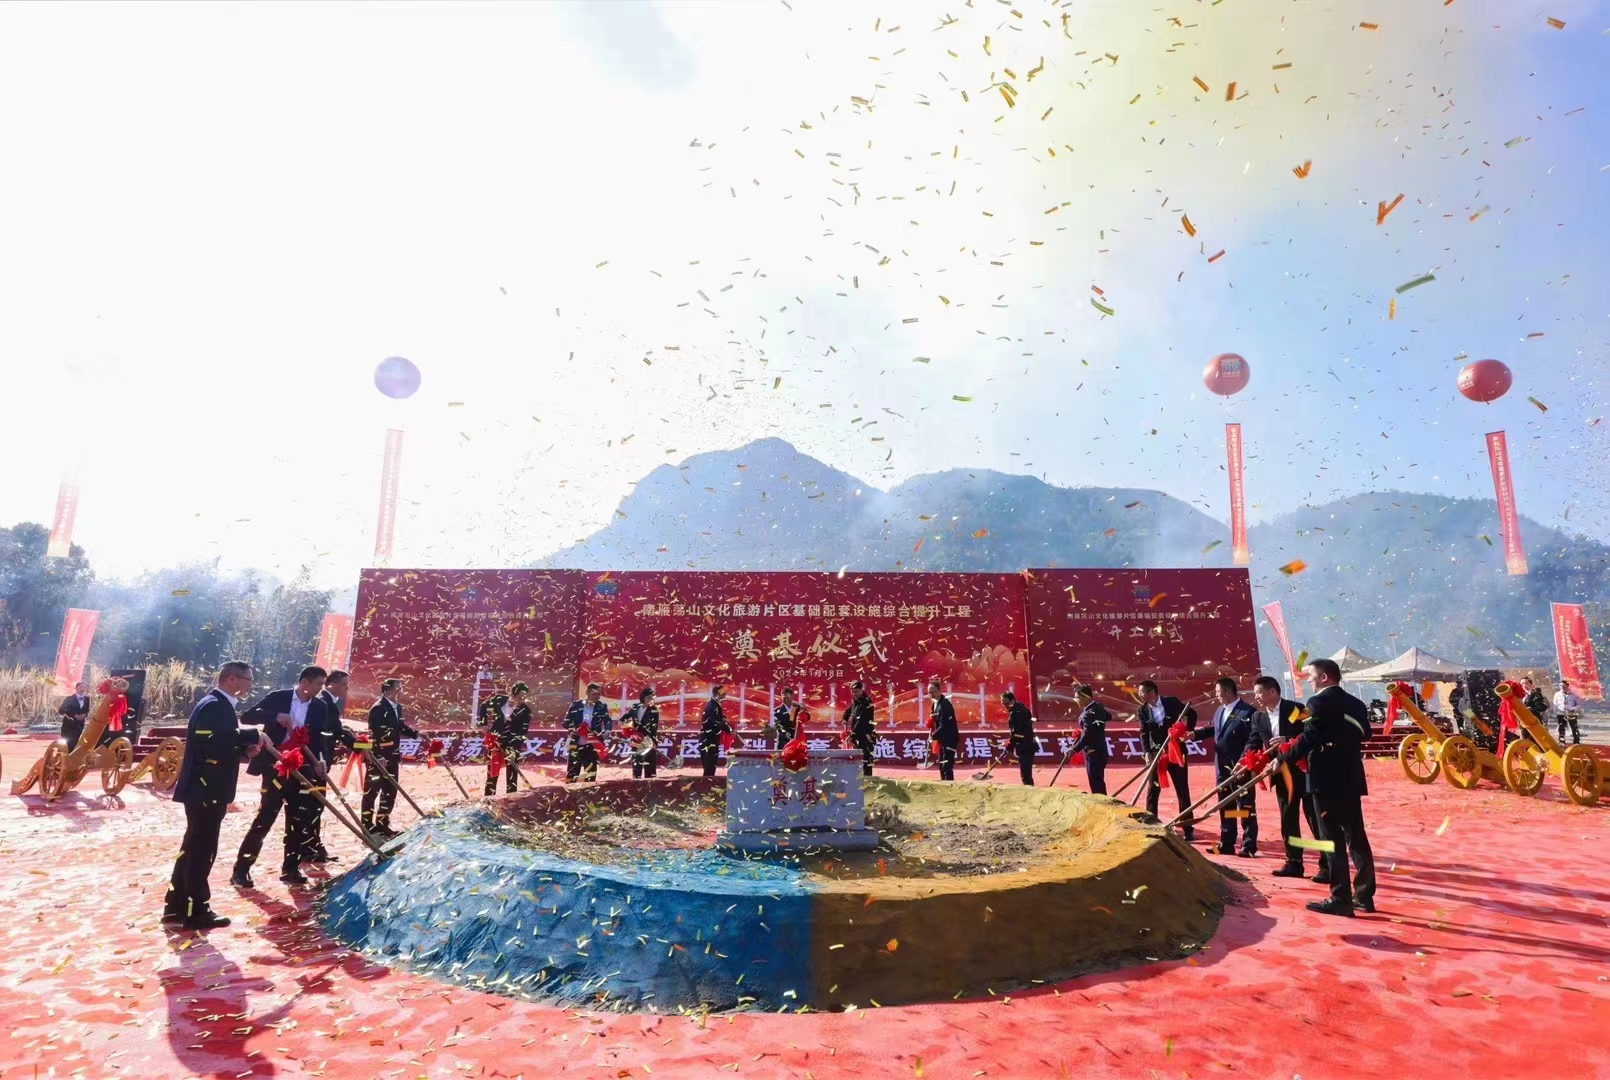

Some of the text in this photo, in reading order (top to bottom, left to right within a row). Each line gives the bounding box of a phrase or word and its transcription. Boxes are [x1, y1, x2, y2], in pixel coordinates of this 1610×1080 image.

[642, 603, 971, 617] 南雁荡山文化旅游片区基础配套设施综合提升工程
[731, 628, 888, 663] 奠基仪式
[1108, 624, 1183, 643] 开工仪式
[768, 776, 820, 806] 奠基
